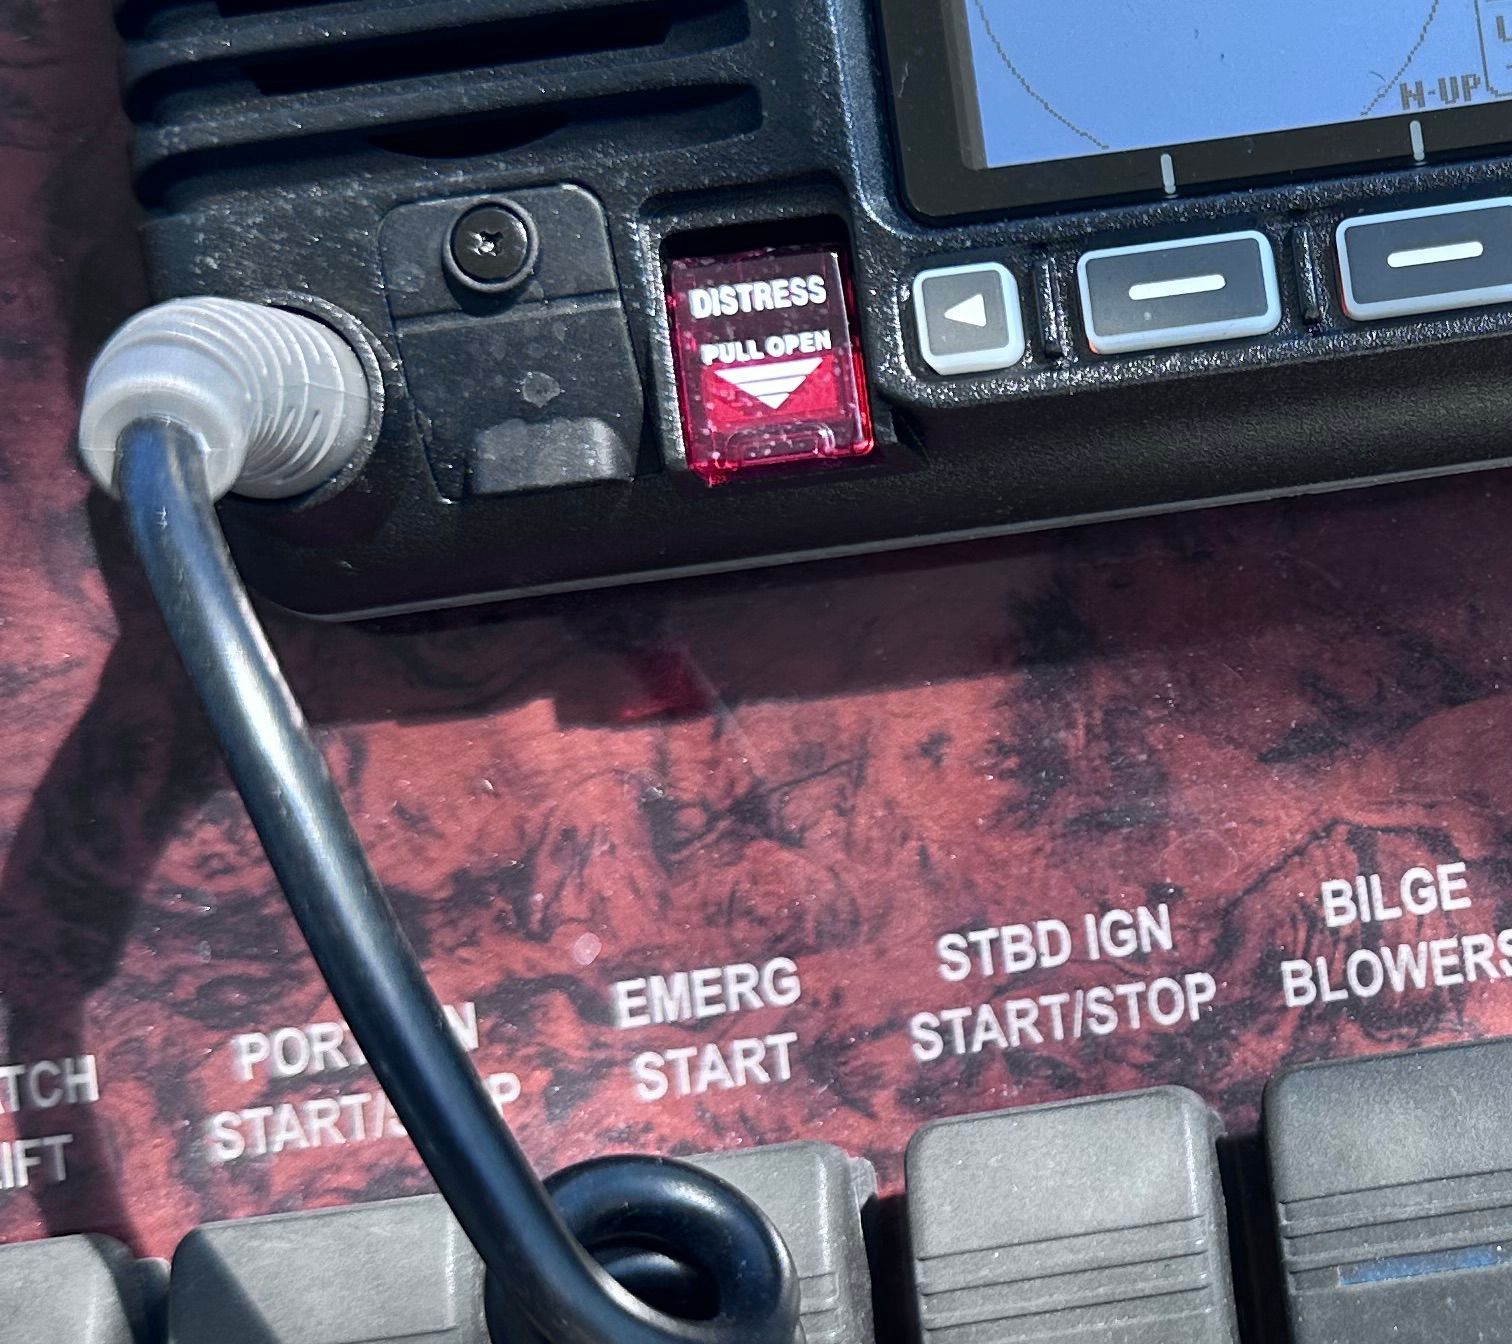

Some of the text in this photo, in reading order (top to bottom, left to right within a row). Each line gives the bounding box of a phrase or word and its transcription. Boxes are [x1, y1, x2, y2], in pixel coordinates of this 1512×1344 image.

[688, 274, 827, 319] DISTRESS
[700, 329, 832, 366] PULL OPEN
[1320, 862, 1473, 928] BILGE
[937, 902, 1174, 982] STBD IGN
[611, 956, 802, 1031] EMERG
[908, 971, 1218, 1063] START/STOP
[0, 1054, 99, 1114] TCH
[631, 1032, 798, 1103] START
